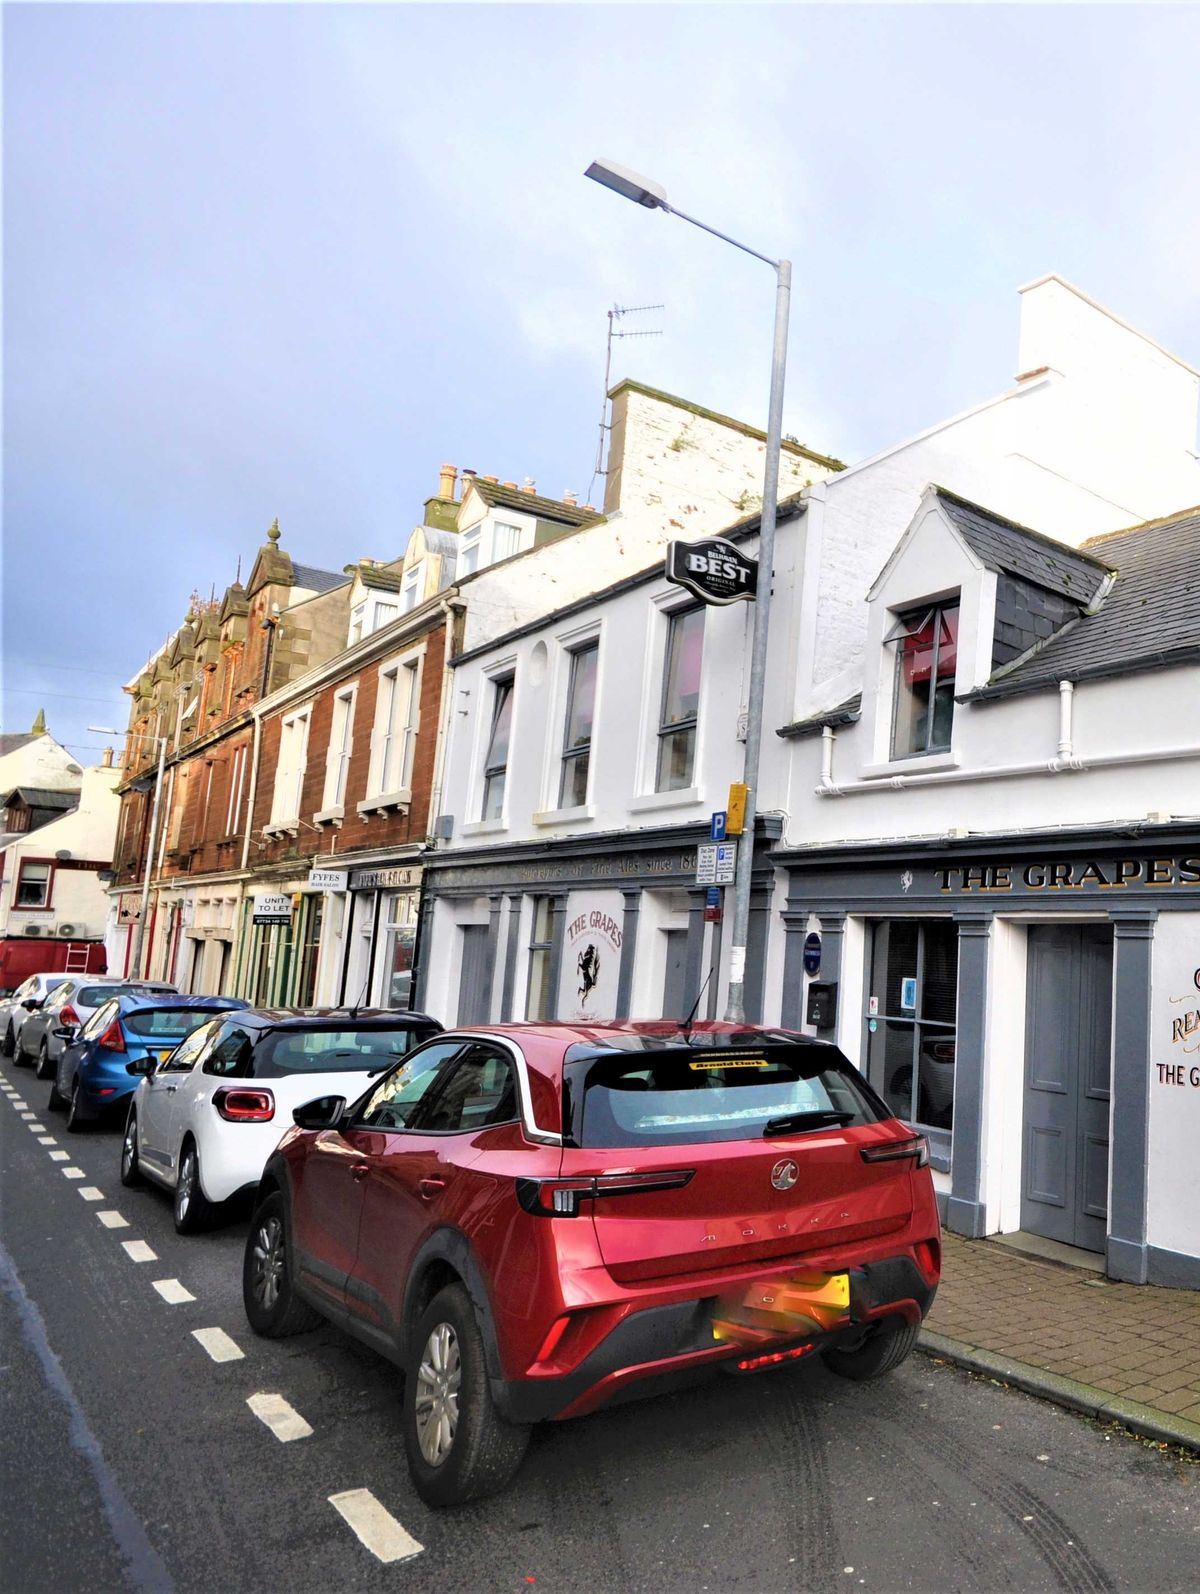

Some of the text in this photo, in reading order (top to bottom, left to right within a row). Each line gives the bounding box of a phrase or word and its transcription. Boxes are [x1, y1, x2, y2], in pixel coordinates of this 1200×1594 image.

[688, 553, 751, 584] BEST
[714, 814, 724, 838] P
[312, 873, 340, 881] FYFES
[934, 865, 1014, 893] THE
[568, 914, 587, 940] THE
[590, 911, 623, 948] GRAPES
[1156, 1063, 1186, 1087] THE
